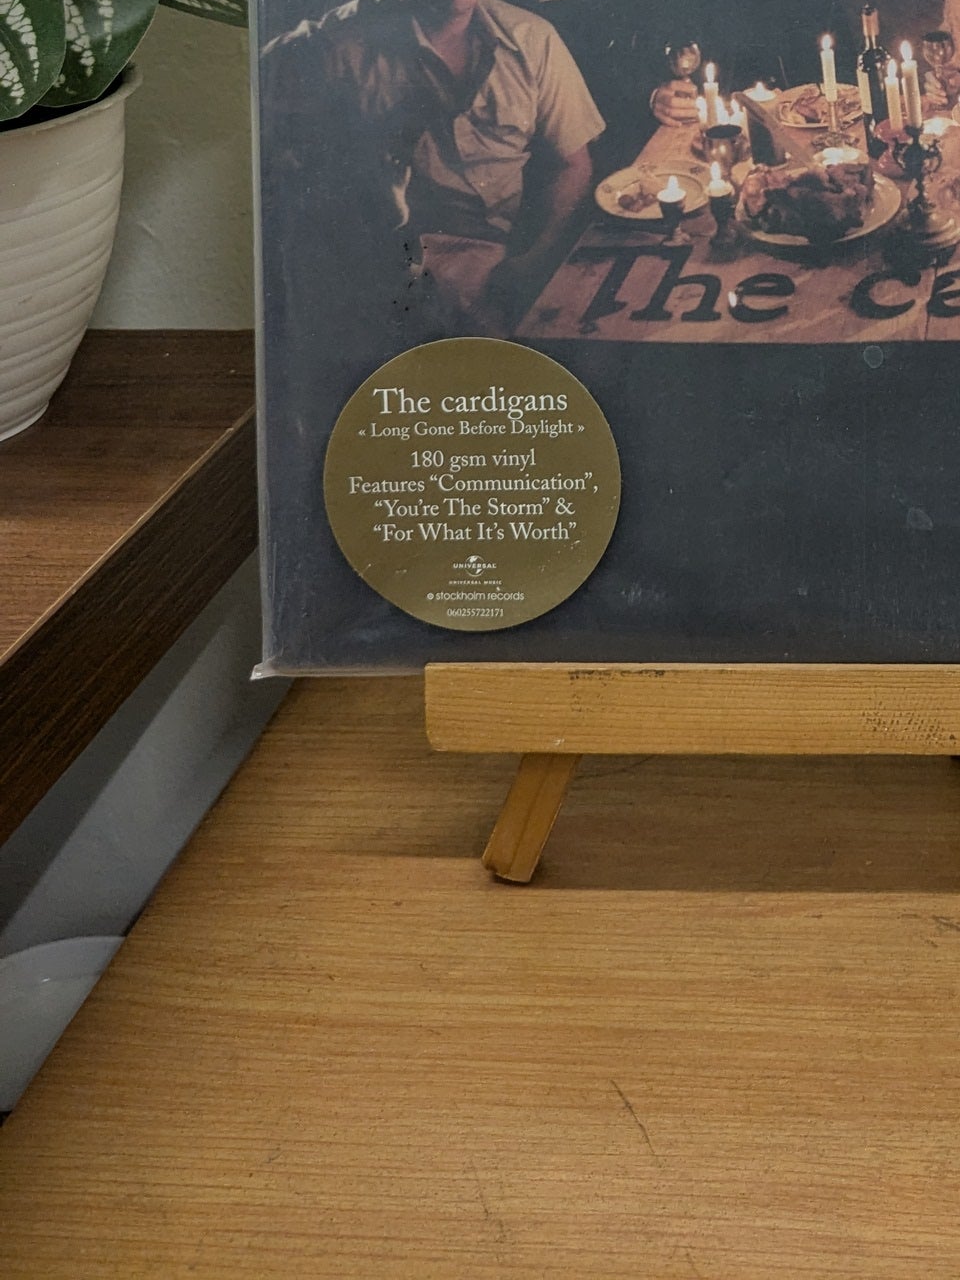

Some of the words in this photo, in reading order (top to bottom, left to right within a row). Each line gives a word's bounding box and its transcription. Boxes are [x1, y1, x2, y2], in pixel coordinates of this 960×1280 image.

[568, 244, 796, 324] The
[372, 387, 431, 414] The
[441, 386, 568, 420] cardigans
[371, 422, 410, 440] Long
[414, 421, 454, 437] Gone
[460, 420, 506, 436] Before
[511, 419, 573, 439] Daylight
[411, 450, 444, 468] 180
[450, 454, 487, 472] gsm
[492, 448, 537, 471] vinyl
[349, 475, 425, 494] Features
[443, 498, 482, 516] The
[487, 497, 550, 515] Storm”
[555, 497, 576, 515] &
[418, 522, 473, 541] What
[477, 522, 505, 540] It’s
[510, 521, 577, 540] Worth”
[452, 562, 498, 570] UNIVERSAL
[435, 591, 486, 601] stockholm
[487, 591, 526, 601] records
